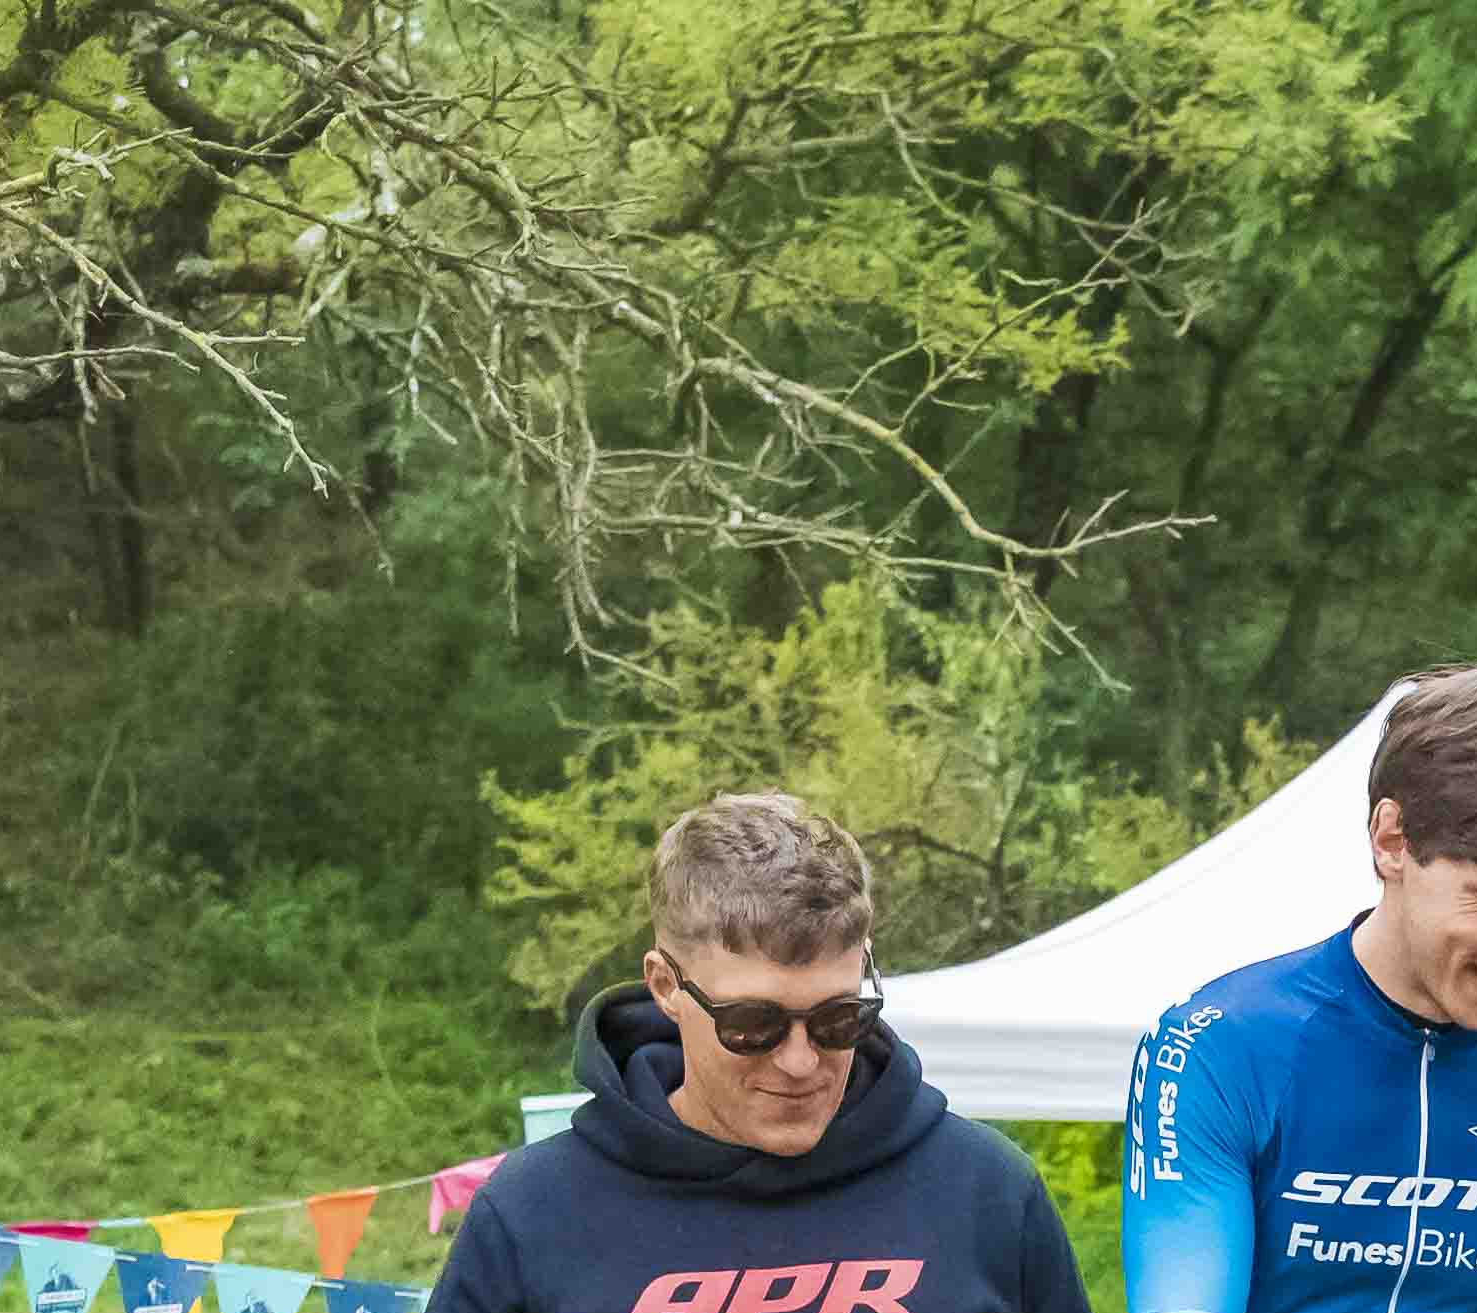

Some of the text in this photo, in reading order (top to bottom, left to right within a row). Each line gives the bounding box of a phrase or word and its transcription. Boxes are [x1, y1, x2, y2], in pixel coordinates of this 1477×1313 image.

[1153, 1005, 1223, 1181] Funes Bikes
[1286, 1222, 1404, 1266] Funes
